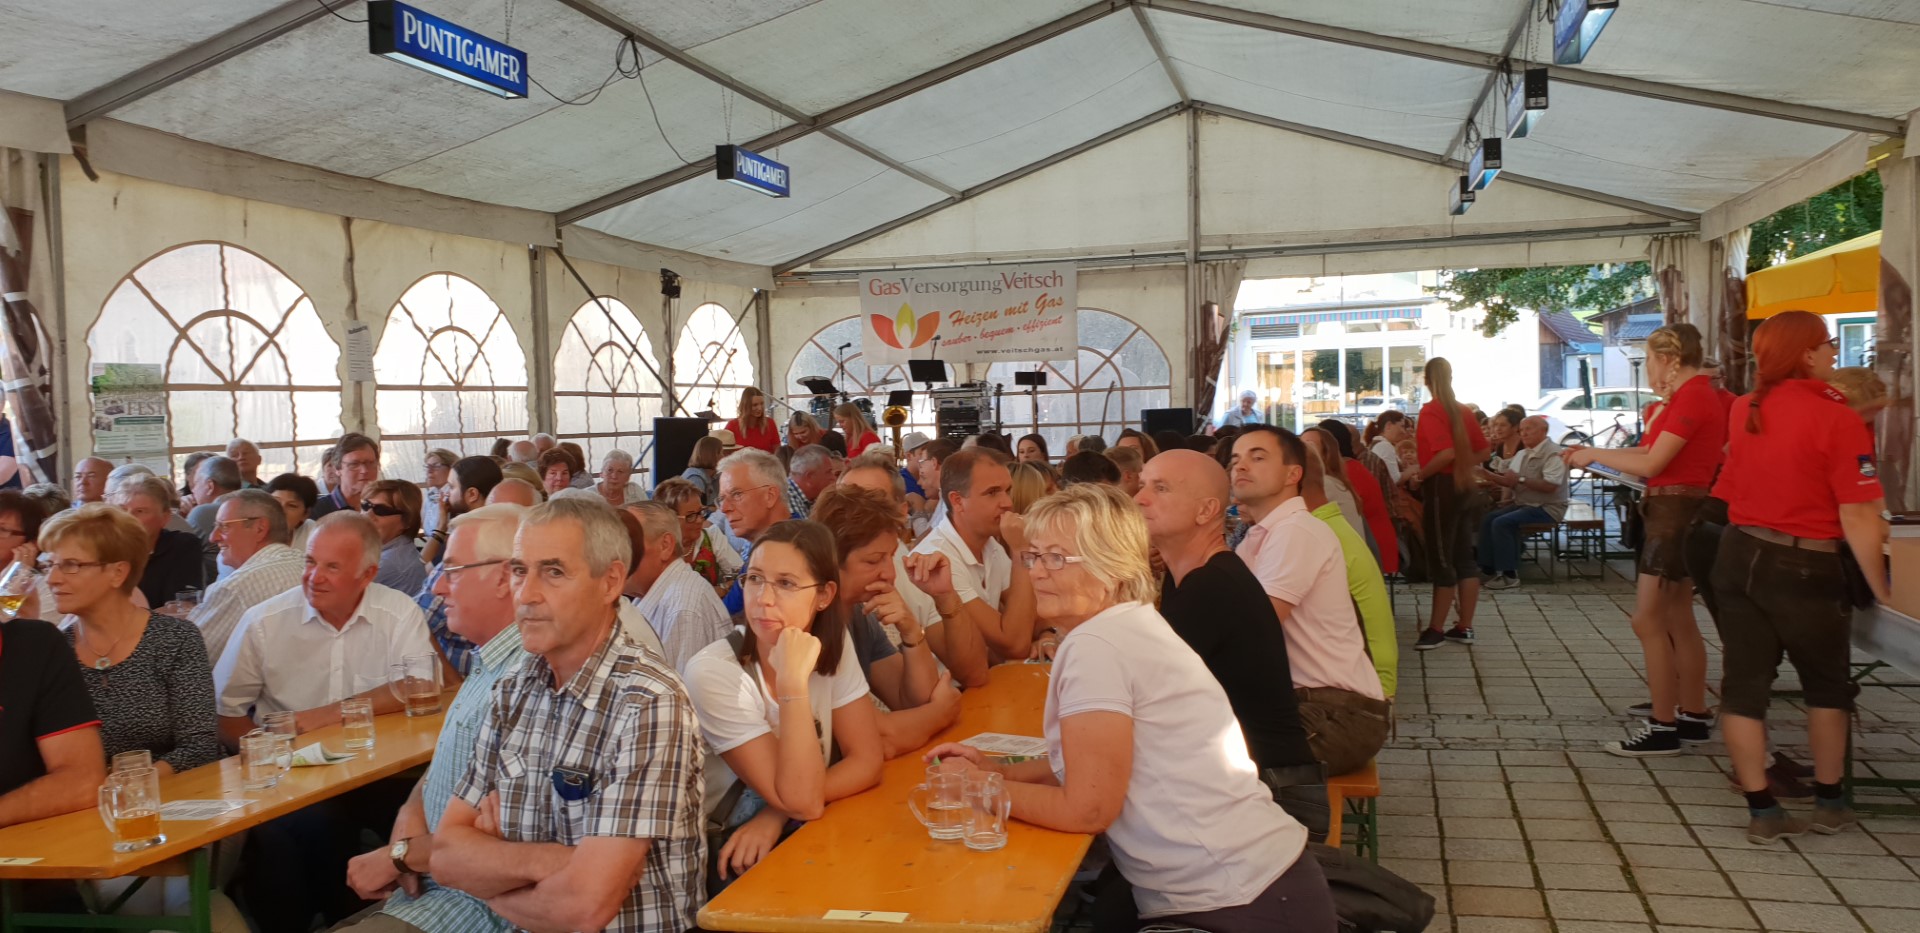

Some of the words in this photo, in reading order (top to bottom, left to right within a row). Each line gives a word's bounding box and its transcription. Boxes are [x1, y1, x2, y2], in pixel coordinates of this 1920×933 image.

[403, 10, 521, 84] PUNTIGAMER
[736, 150, 787, 188] PUNTIGAMER
[868, 270, 1064, 297] GasVersorgungVeitsch
[949, 309, 999, 327] Heizen
[1004, 300, 1029, 317] mit
[1035, 292, 1064, 316] Gas
[941, 332, 972, 347] sauber
[980, 328, 1014, 341] bequem
[1022, 315, 1063, 333] effizient
